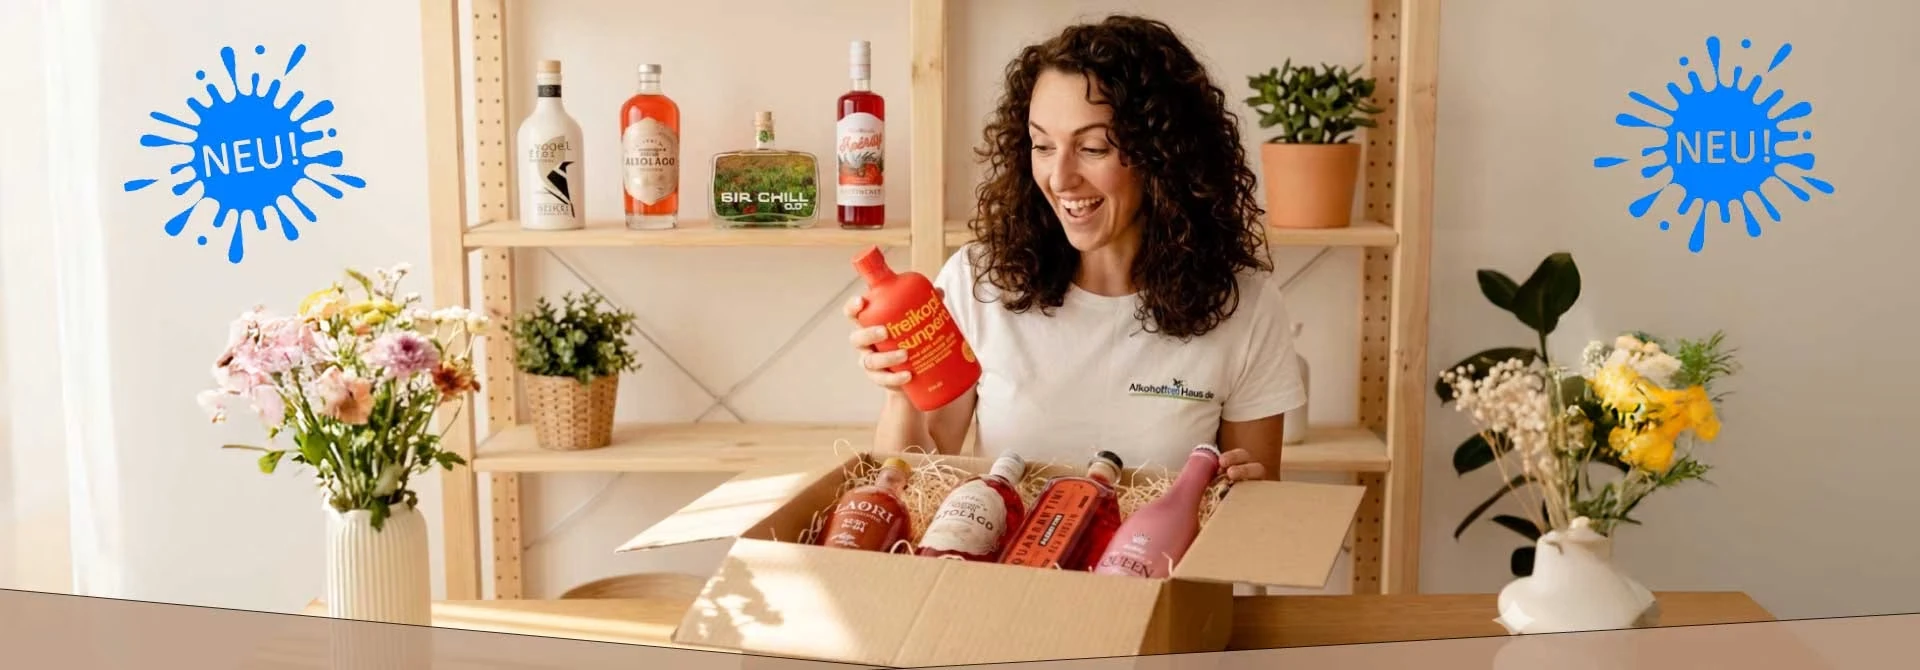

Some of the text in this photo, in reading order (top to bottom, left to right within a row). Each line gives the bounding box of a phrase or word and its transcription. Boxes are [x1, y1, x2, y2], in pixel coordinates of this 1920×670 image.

[757, 192, 809, 203] CHILL
[834, 501, 894, 523] LAORI
[1101, 556, 1154, 578] QUEEN
